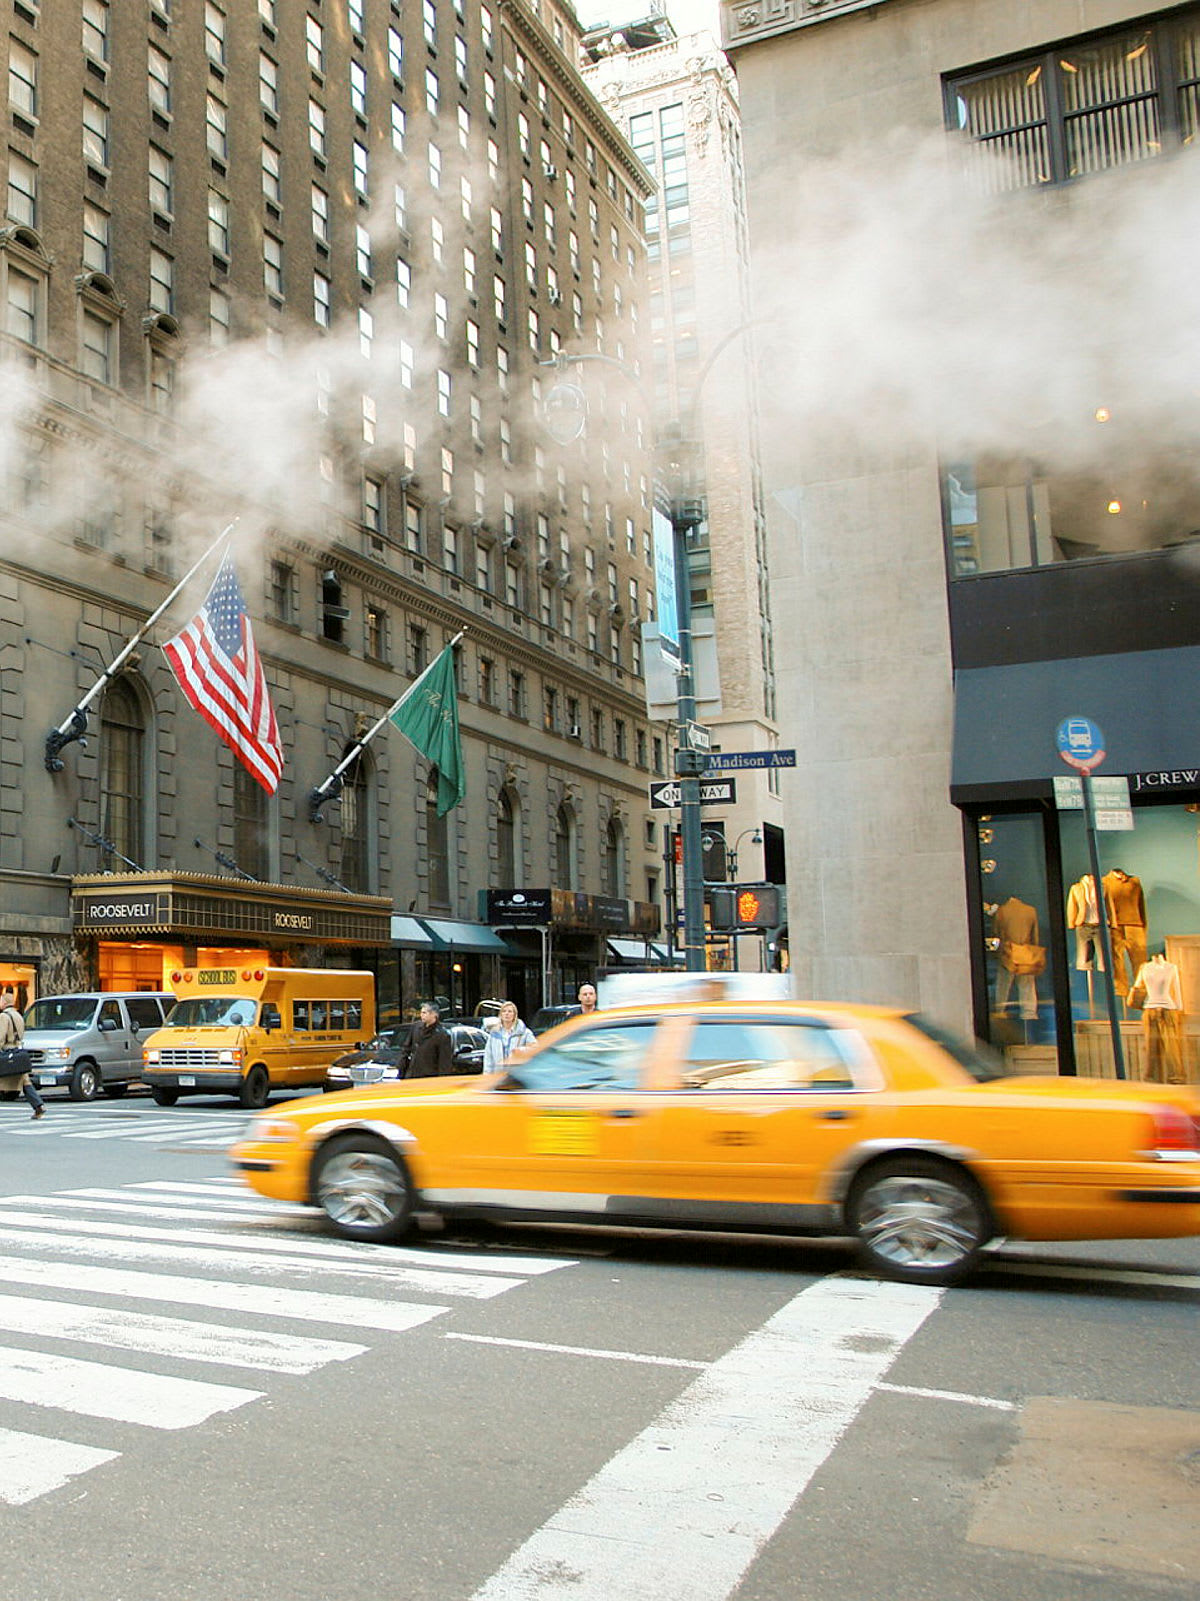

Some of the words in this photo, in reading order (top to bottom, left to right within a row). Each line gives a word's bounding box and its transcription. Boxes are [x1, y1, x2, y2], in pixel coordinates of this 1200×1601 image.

[708, 755, 765, 769] Madison
[770, 753, 794, 766] Ave
[1135, 770, 1199, 790] J.CREW
[663, 789, 680, 801] ON
[90, 903, 150, 919] ROOSEVELT
[275, 913, 313, 930] ROOSEVELT
[199, 970, 221, 984] SCHOOL
[222, 970, 237, 984] BUS
